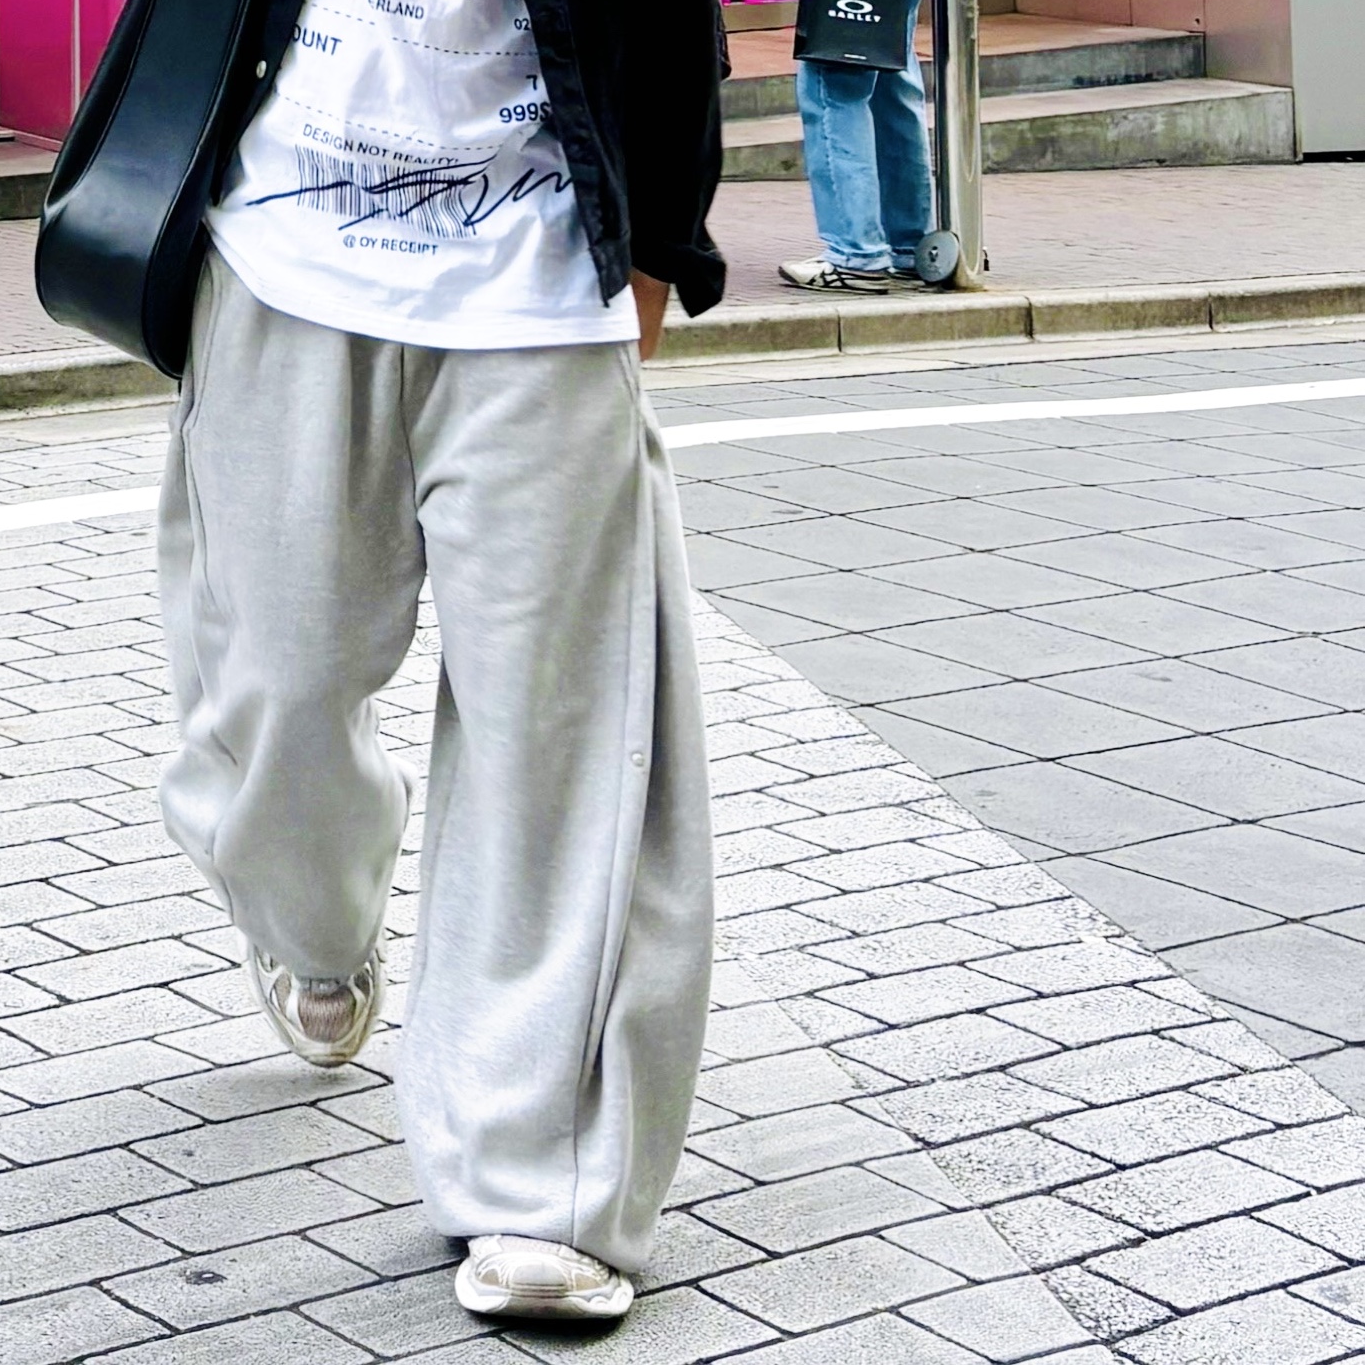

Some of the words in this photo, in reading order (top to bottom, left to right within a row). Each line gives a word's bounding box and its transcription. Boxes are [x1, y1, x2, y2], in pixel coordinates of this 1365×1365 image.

[302, 123, 354, 153] DESIGN
[356, 140, 390, 158] NOT
[359, 235, 378, 249] OY
[380, 237, 439, 256] RECEIPT
